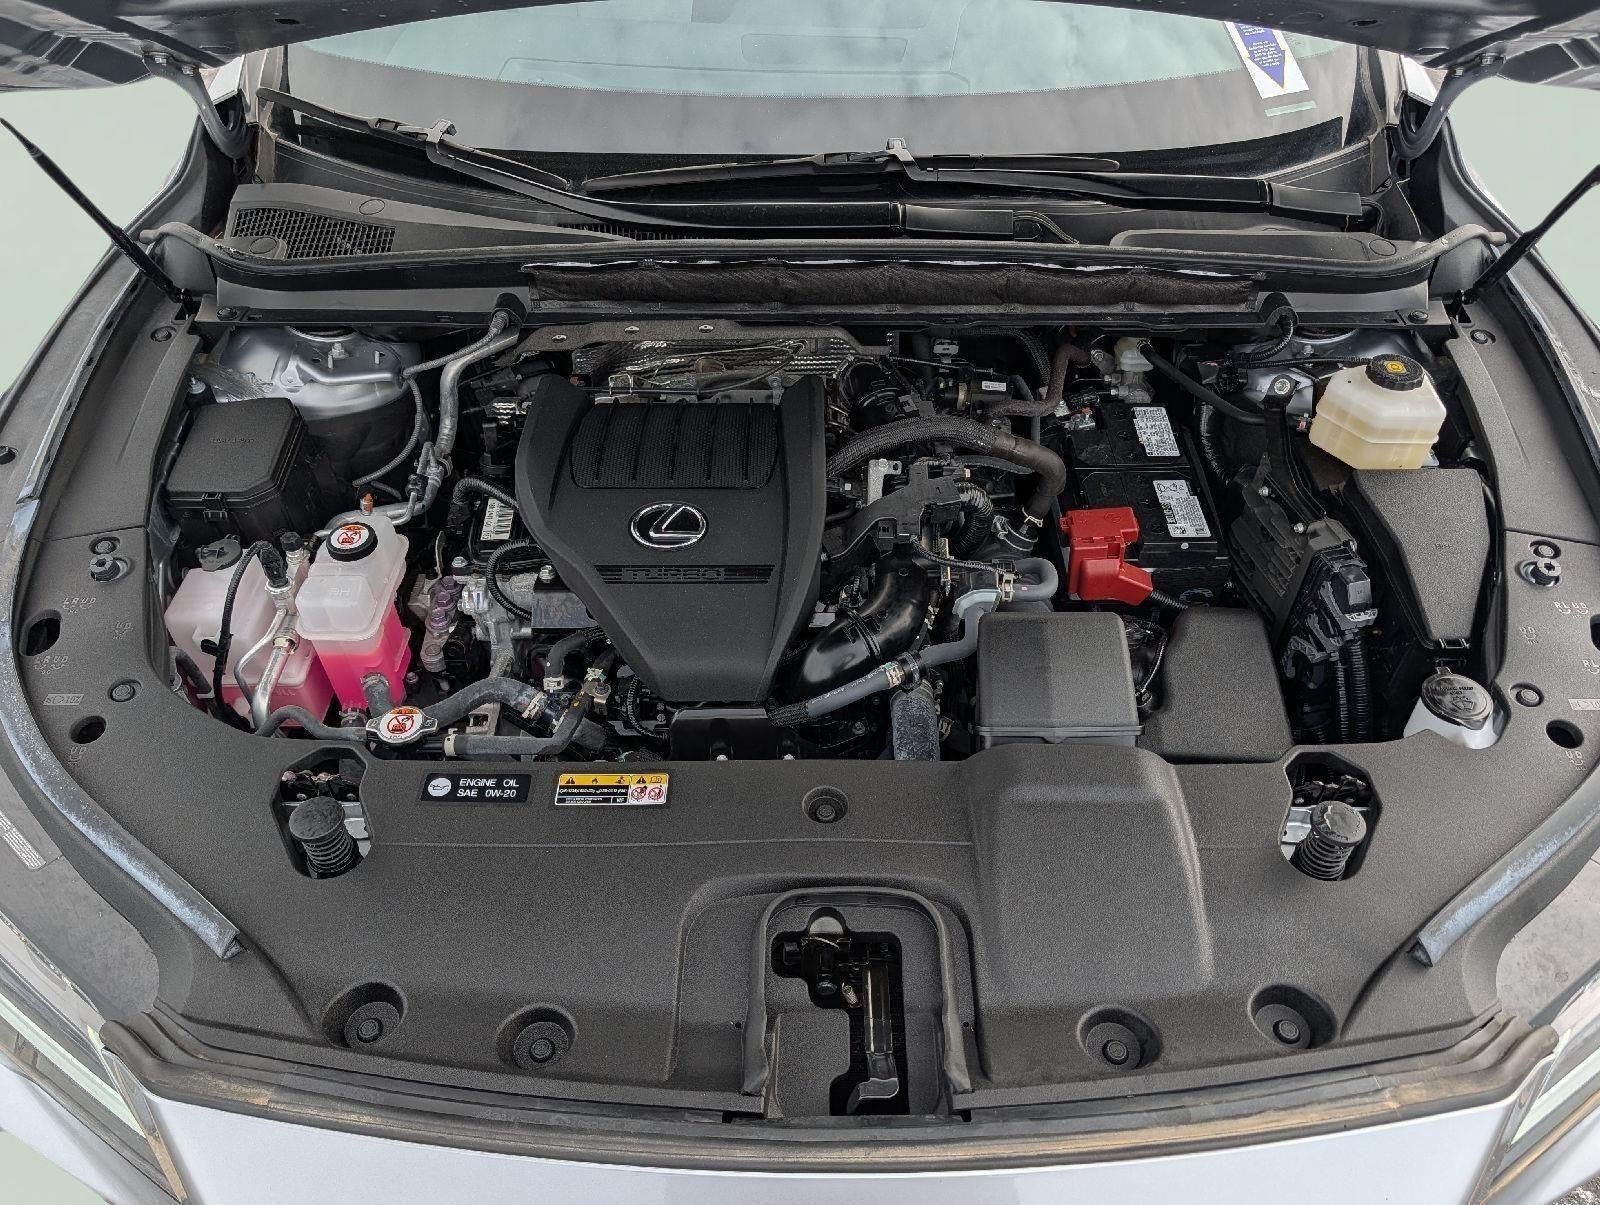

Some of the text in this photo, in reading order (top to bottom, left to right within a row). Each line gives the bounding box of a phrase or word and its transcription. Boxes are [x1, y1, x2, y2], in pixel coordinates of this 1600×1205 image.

[625, 568, 722, 581] TURBO
[459, 778, 520, 787] ENGINE OIL
[456, 788, 517, 798] SAE 0W-20
